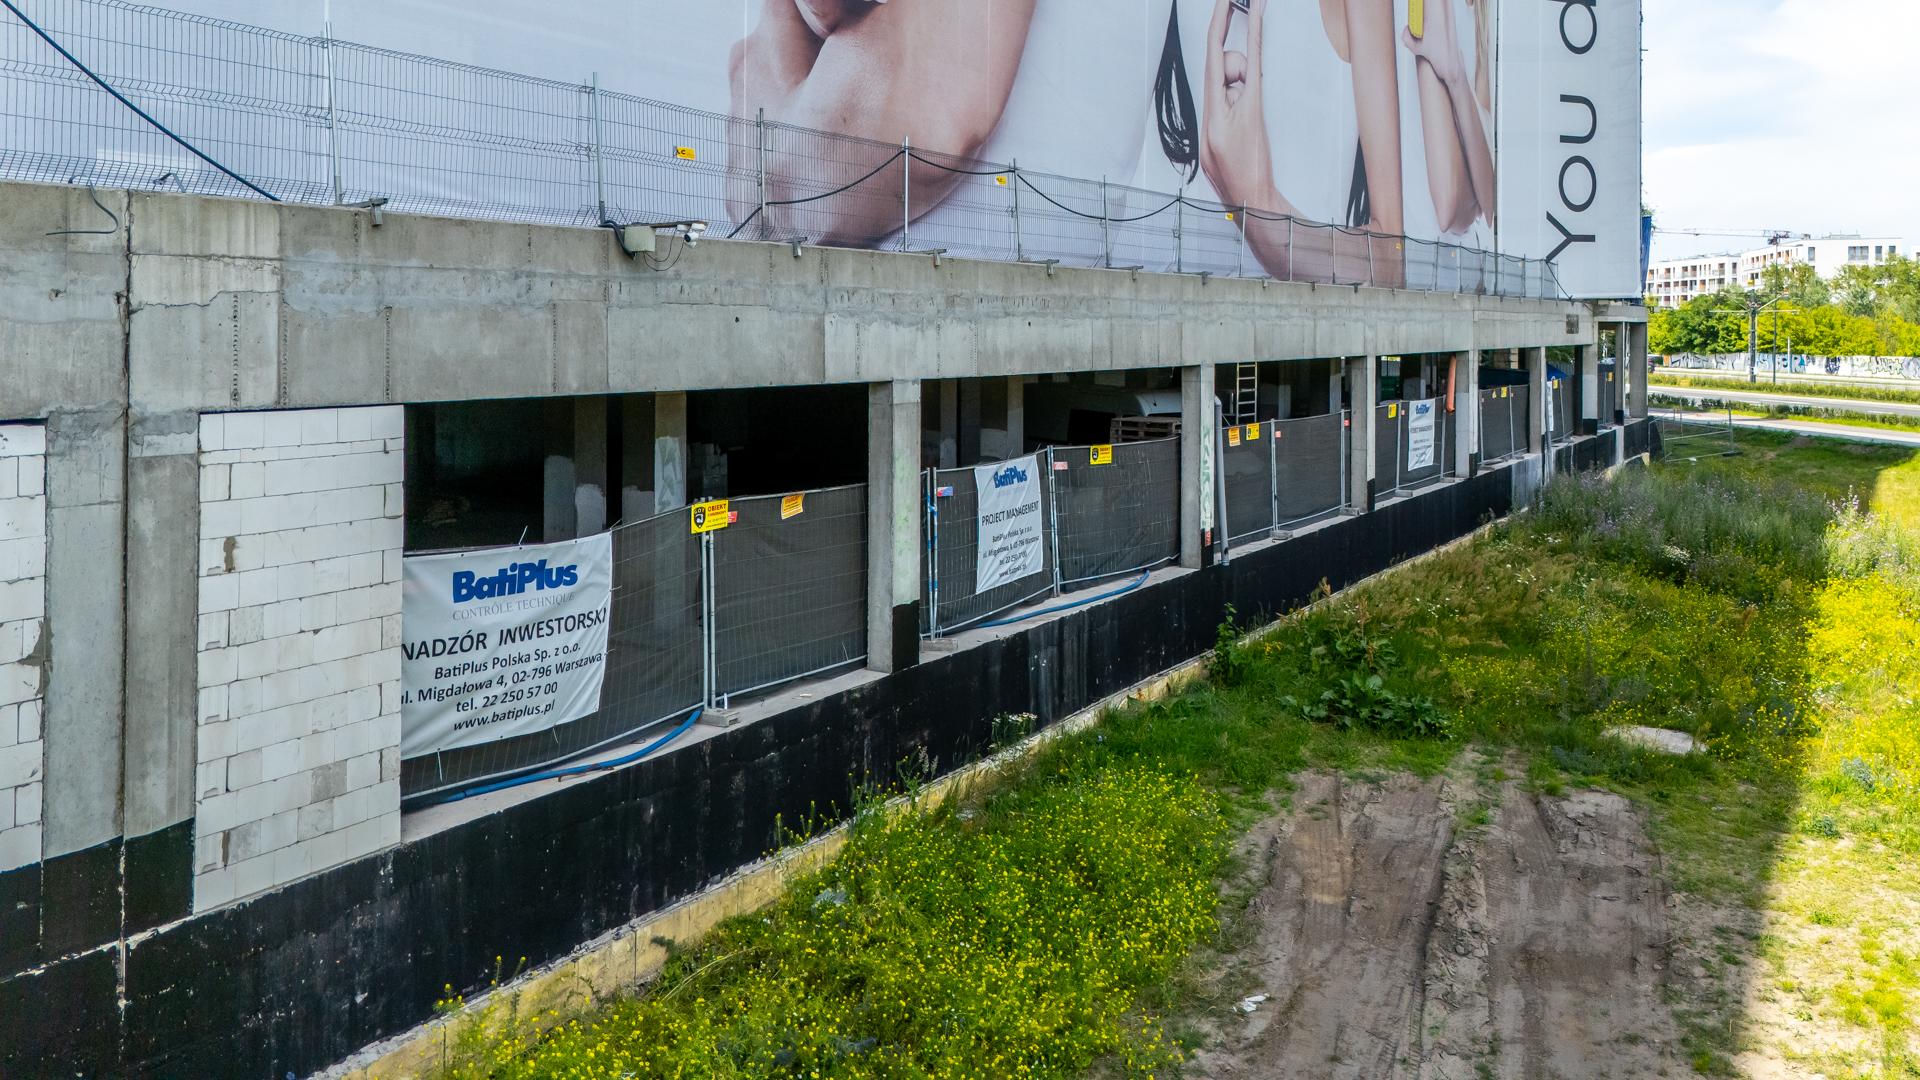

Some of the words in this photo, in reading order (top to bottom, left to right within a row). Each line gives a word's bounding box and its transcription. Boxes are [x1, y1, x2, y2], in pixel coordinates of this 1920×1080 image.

[1546, 94, 1597, 263] You
[707, 503, 727, 512] OBIEKT
[981, 511, 1005, 527] PROJECT
[1006, 501, 1039, 520] MANAGEMENT
[453, 559, 578, 603] BatiPlus
[452, 601, 514, 621] CONTRÔLE
[517, 592, 577, 611] TECHNIQUE
[401, 629, 487, 661] NADZÓR
[499, 607, 606, 647] INWESTORSKI
[418, 679, 493, 702] Migdałowa
[496, 674, 508, 688] 4,
[512, 664, 552, 684] 02-796
[555, 653, 602, 674] Warszawa
[434, 661, 488, 679] BatiPlus
[492, 652, 531, 669] Polska
[534, 648, 551, 662] Sp.
[554, 647, 559, 657] z
[562, 643, 581, 655] o.o.
[456, 697, 478, 712] tel.
[482, 694, 498, 708] 22
[500, 689, 524, 704] 250
[526, 685, 541, 699] 57
[544, 681, 558, 695] 00
[453, 699, 556, 731] www.batiplus.pl
